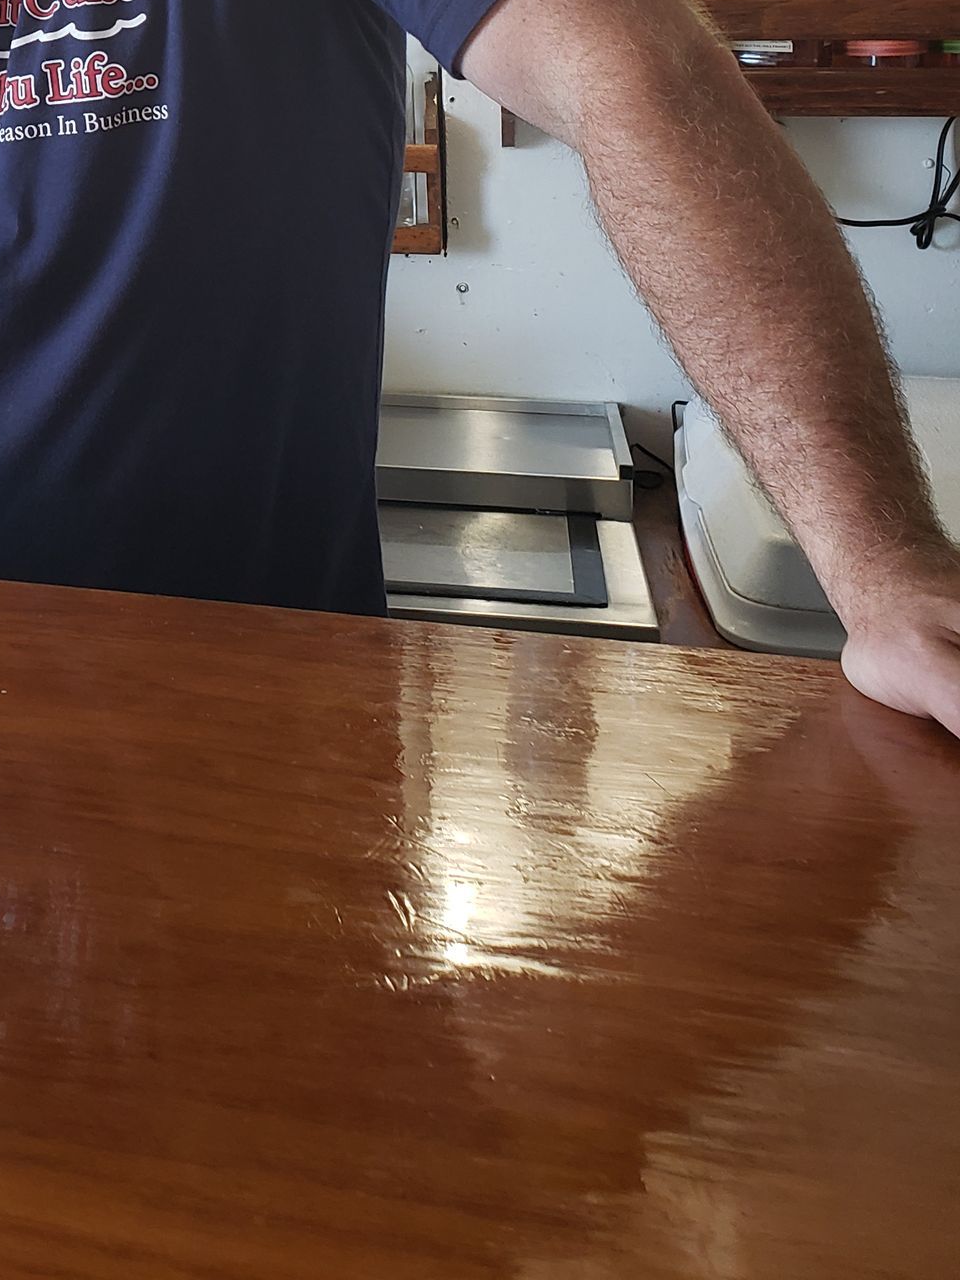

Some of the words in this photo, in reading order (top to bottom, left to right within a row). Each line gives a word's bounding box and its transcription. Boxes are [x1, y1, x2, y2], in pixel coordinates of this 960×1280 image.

[42, 52, 159, 106] Life...
[57, 114, 78, 135] In
[83, 104, 169, 133] Business
